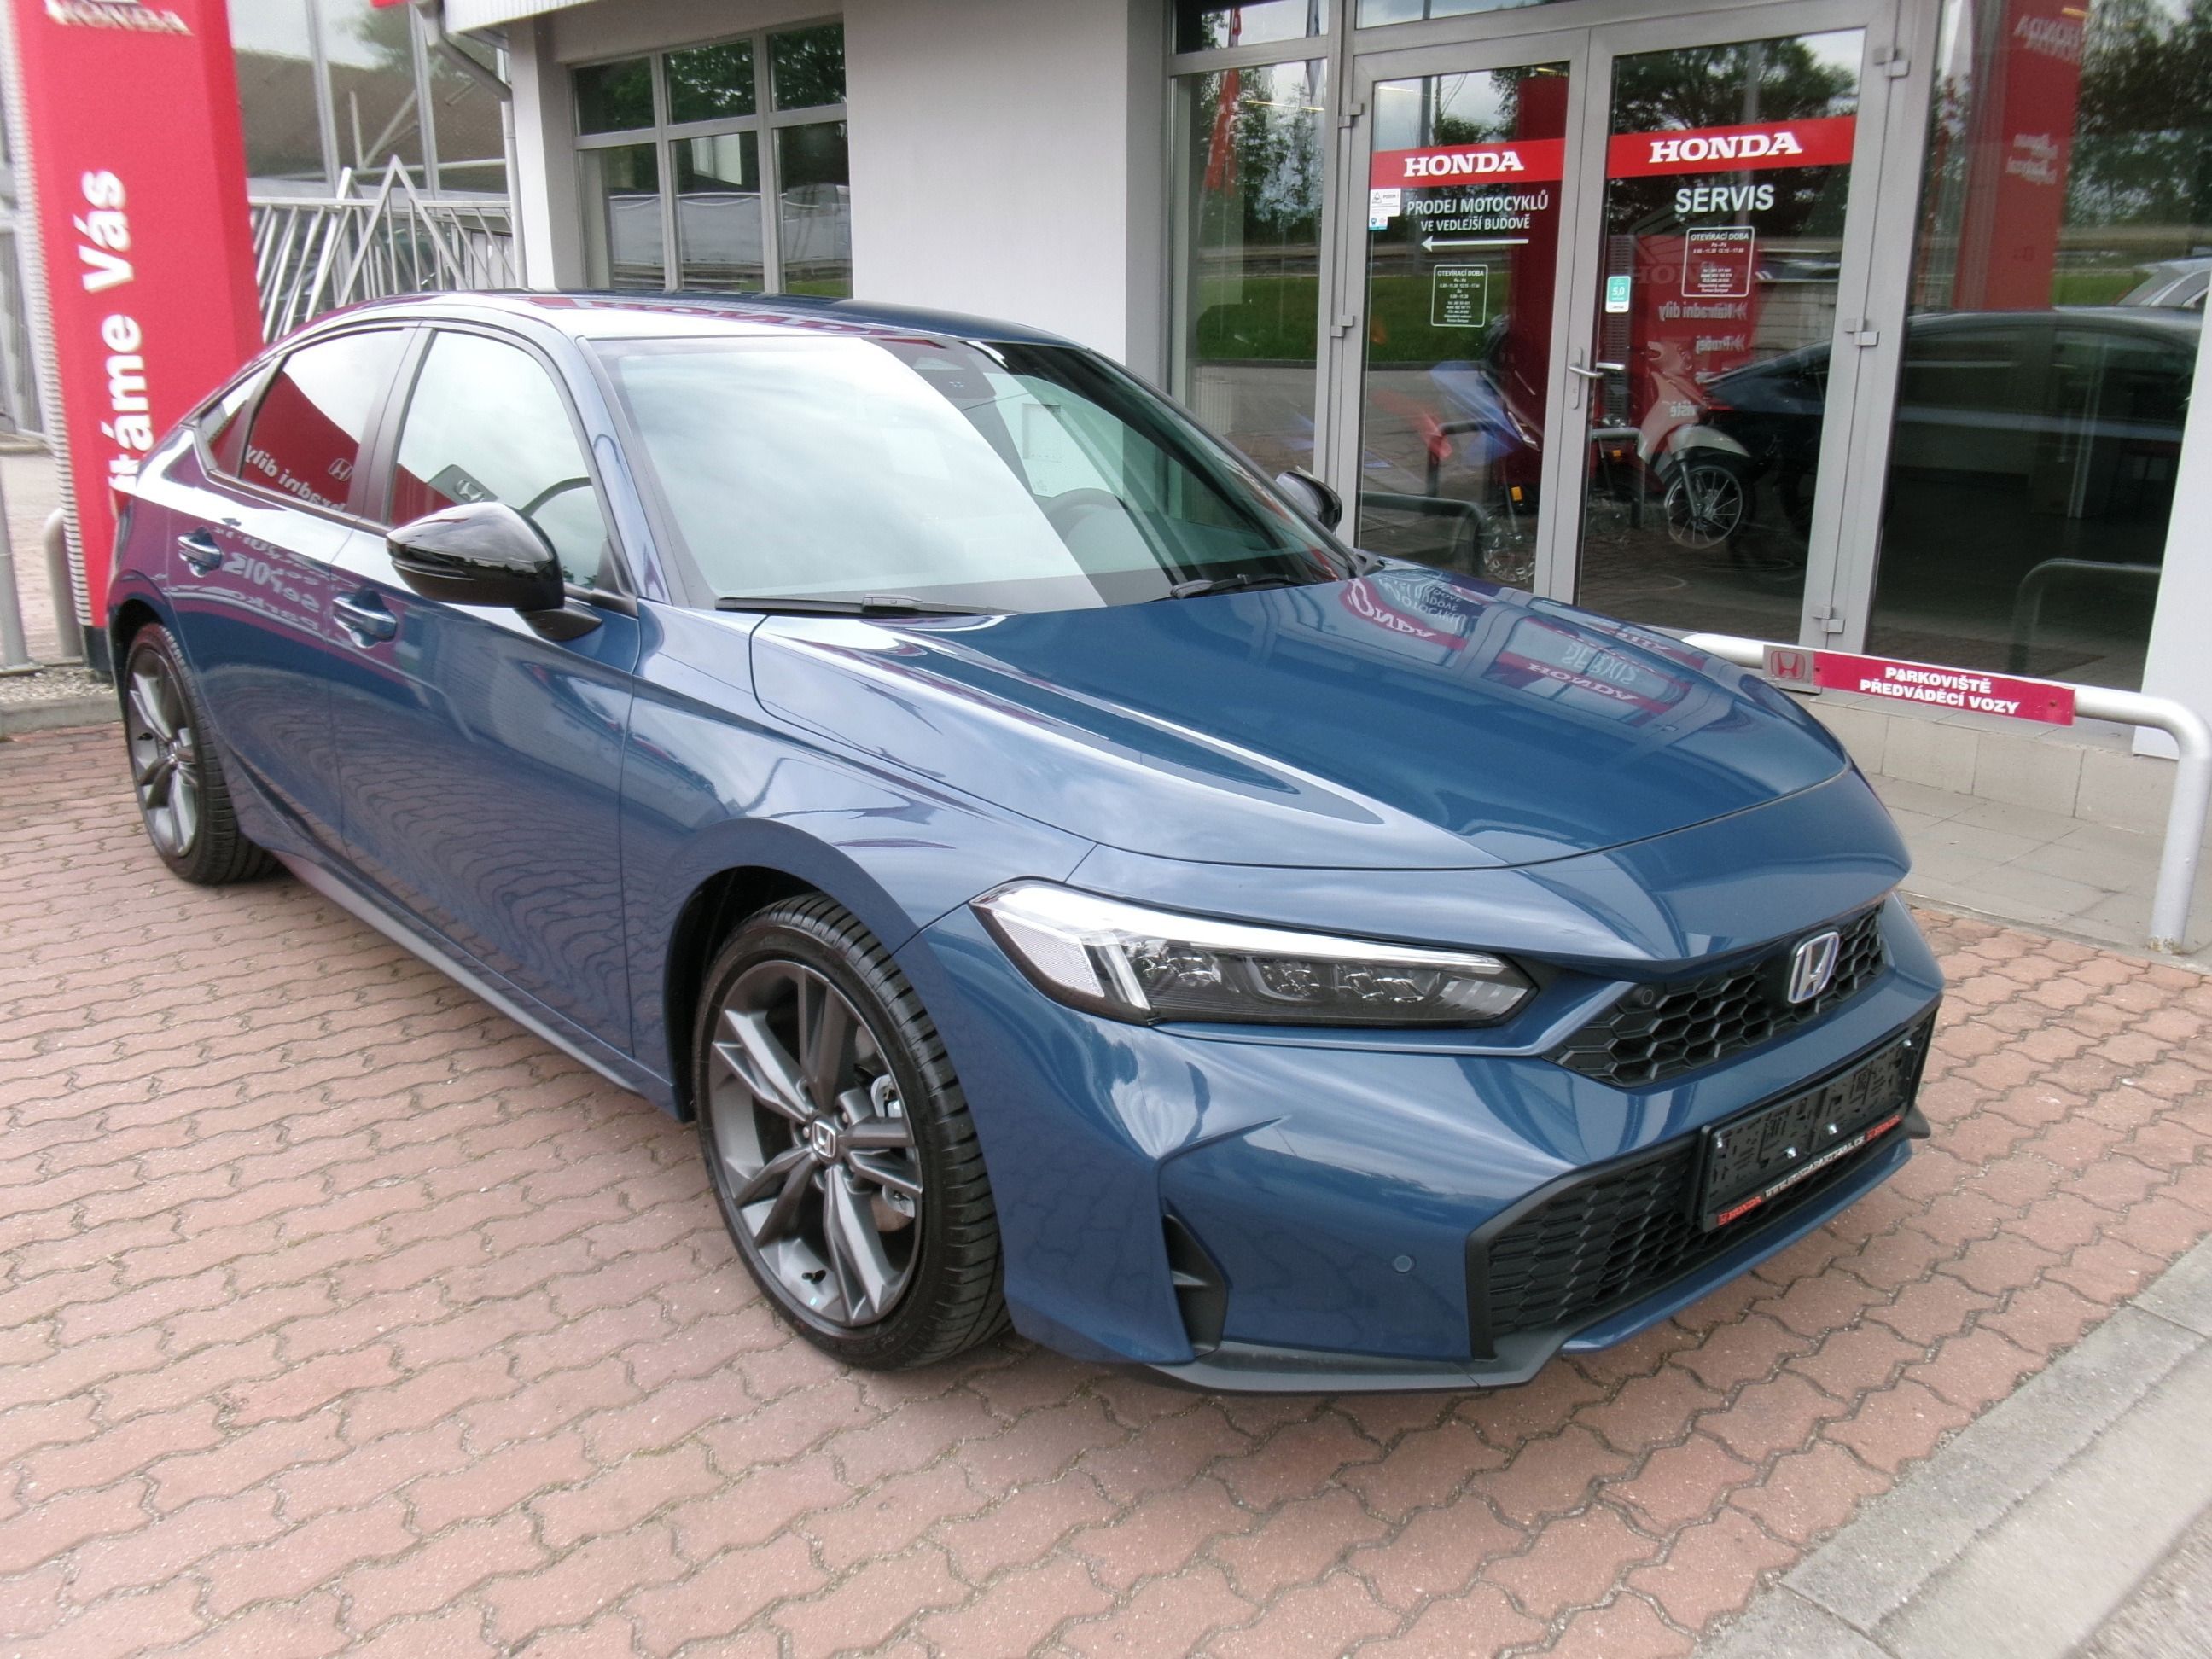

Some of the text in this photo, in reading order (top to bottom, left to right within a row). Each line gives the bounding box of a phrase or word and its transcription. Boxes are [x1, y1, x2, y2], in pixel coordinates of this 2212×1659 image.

[1649, 131, 1802, 163] HONDA
[1404, 151, 1525, 177] HONDA
[1407, 189, 1549, 215] PRODEJ MOTOCYKLŮ
[1674, 184, 1774, 213] SERVIS
[73, 170, 134, 294] Vás
[1421, 214, 1530, 232] VE VEDLEJŠÍ BUDOVĚ
[1691, 231, 1749, 241] OTEVÍRACÍ DOBA
[1884, 666, 1992, 694] PARKOVIŠTĚ
[1860, 678, 2020, 714] PŘEDVÁDĚCÍ VOZY
